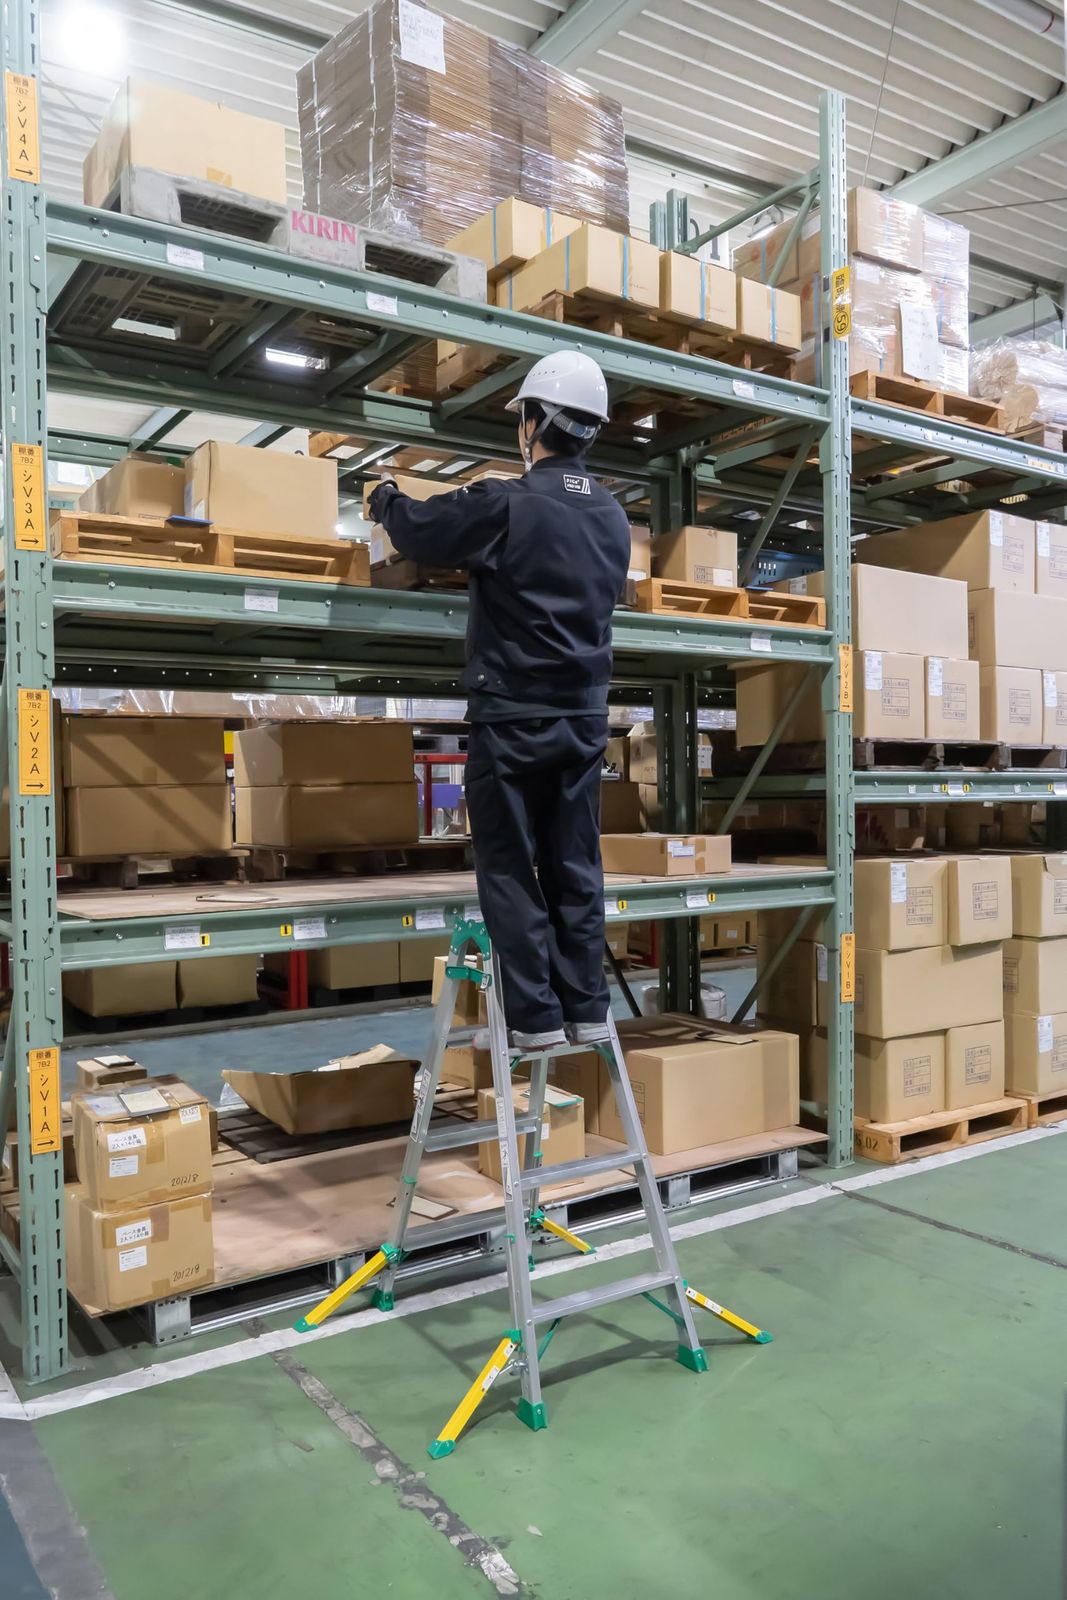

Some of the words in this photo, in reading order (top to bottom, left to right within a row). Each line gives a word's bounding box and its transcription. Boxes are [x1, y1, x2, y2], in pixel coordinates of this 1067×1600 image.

[292, 208, 356, 246] KIRIN
[21, 456, 33, 464] 7B2
[23, 470, 34, 530] シV3A
[30, 715, 41, 775] シV2A
[38, 1060, 51, 1068] 7B2
[40, 1074, 51, 1133] シV1A
